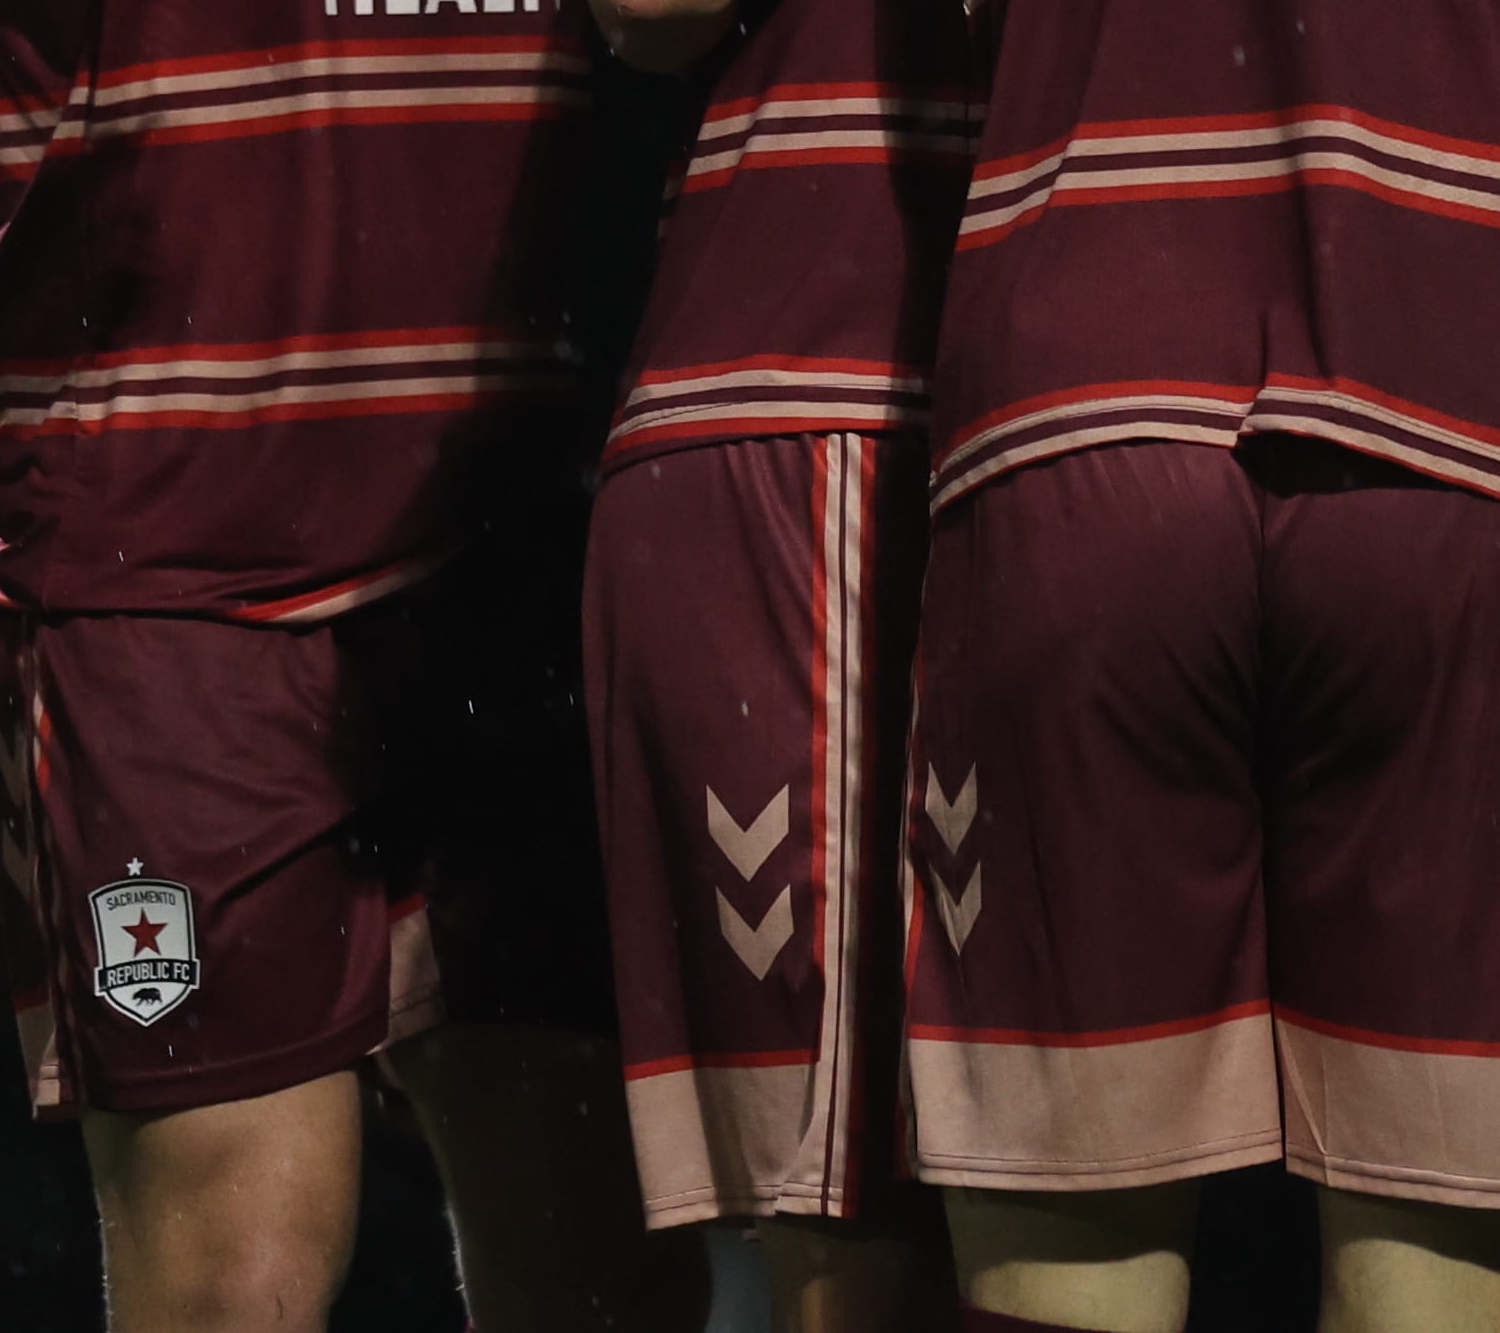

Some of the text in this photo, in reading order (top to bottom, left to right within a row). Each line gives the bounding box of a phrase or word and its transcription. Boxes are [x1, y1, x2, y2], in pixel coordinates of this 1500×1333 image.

[106, 890, 177, 911] SACRAMENTO
[105, 960, 191, 988] REPUBLIC FC
